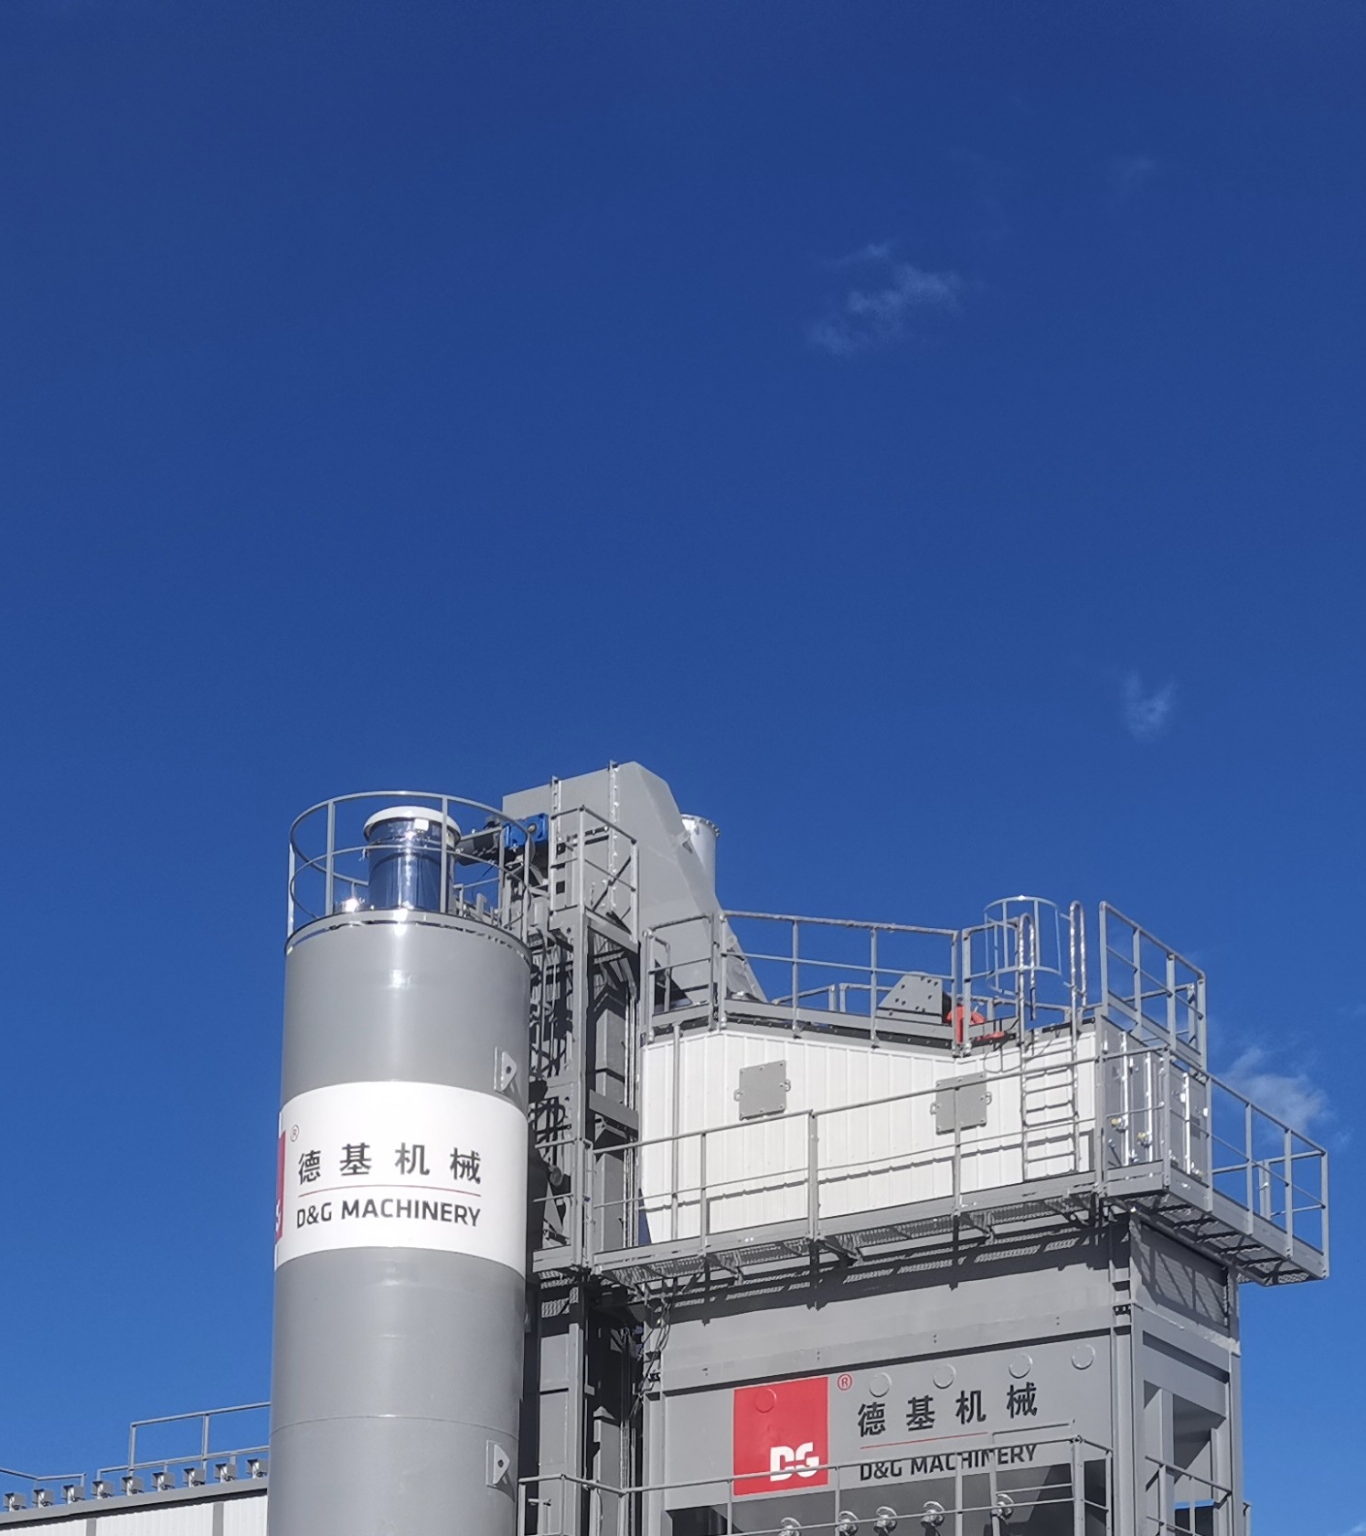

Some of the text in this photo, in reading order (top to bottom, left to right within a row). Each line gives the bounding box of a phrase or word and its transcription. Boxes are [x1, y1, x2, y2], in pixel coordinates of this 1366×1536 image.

[298, 1142, 481, 1184] 德基机械
[296, 1202, 332, 1229] D&G
[341, 1198, 481, 1227] MACHINERY
[857, 1382, 1038, 1437] 德基机械
[860, 1459, 902, 1481] D&G
